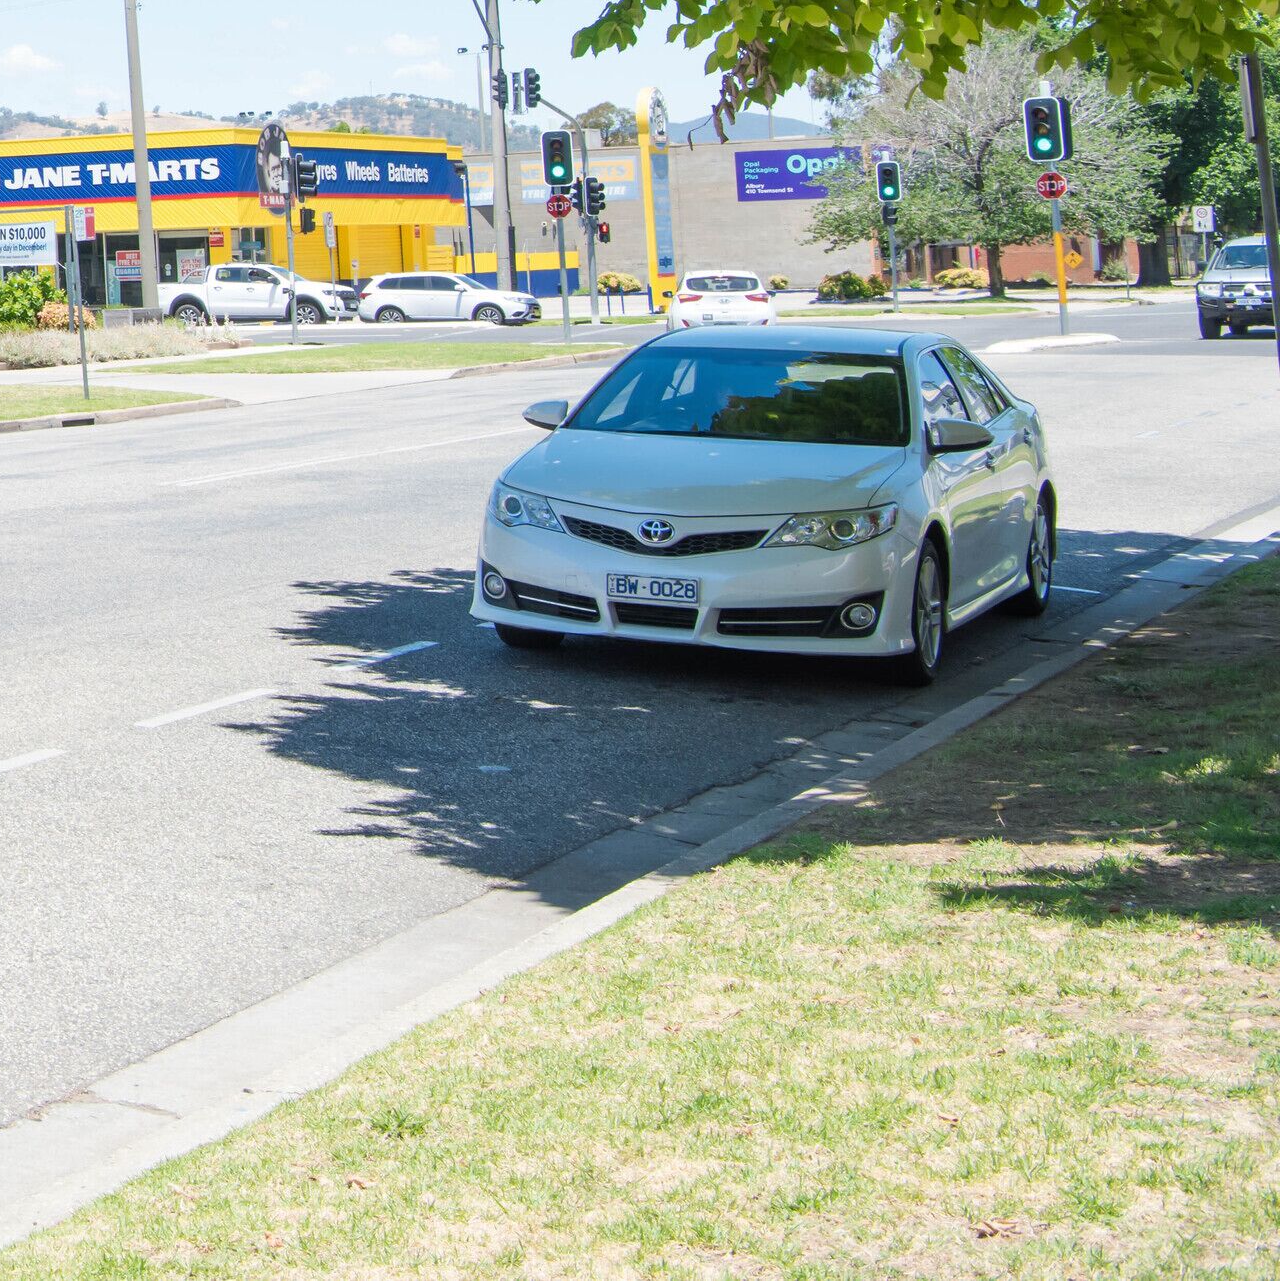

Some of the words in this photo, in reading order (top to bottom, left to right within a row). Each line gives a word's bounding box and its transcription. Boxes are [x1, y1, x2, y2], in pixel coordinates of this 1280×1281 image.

[4, 166, 81, 190] JANE
[87, 157, 220, 185] T-MARTS
[315, 163, 337, 185] yres
[345, 161, 380, 182] Wheels
[387, 162, 429, 183] Batteries
[1039, 181, 1065, 191] STOP
[548, 202, 570, 212] STOP
[8, 226, 46, 242] $10,000
[3, 244, 12, 253] day
